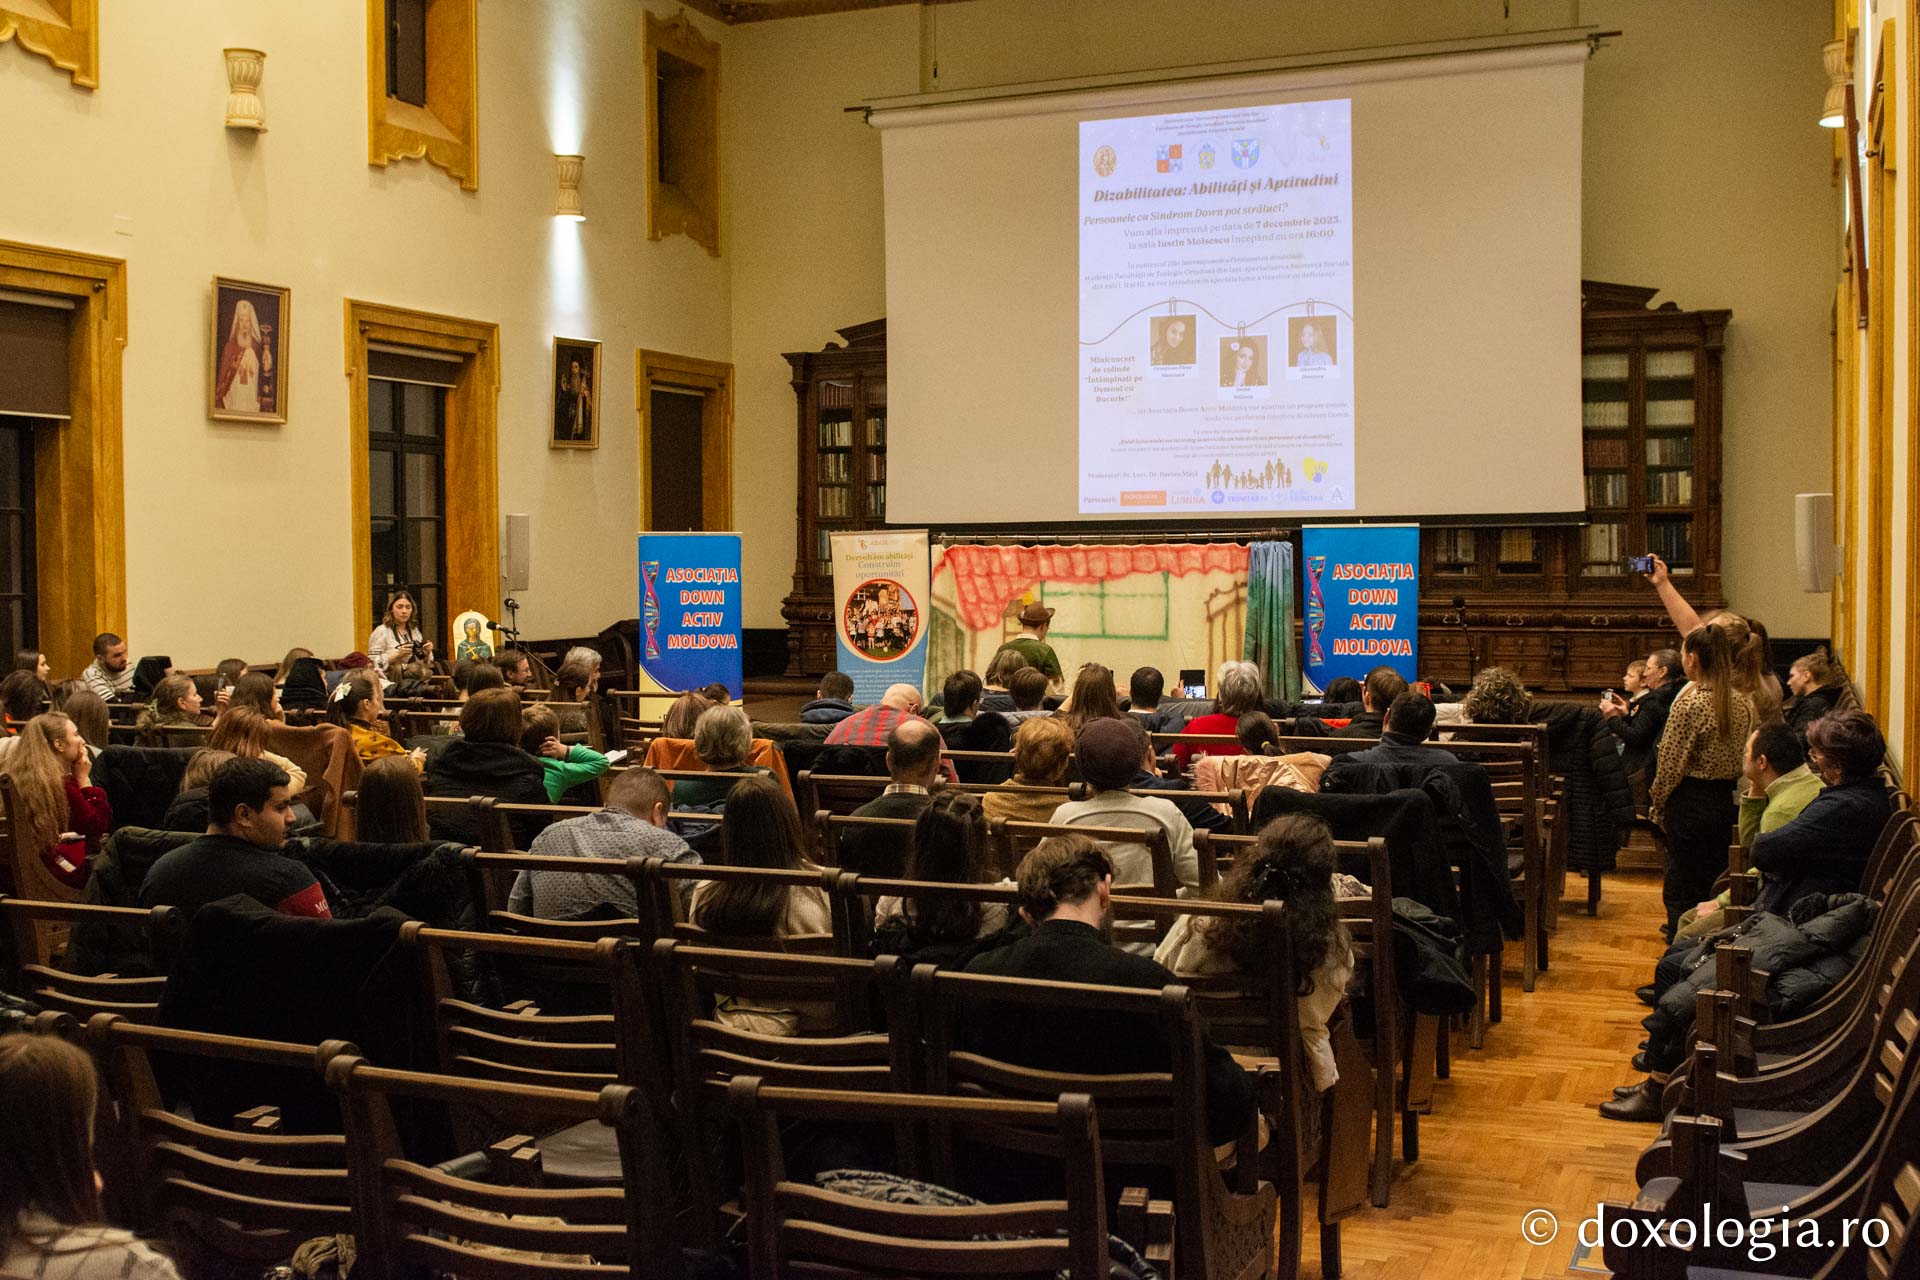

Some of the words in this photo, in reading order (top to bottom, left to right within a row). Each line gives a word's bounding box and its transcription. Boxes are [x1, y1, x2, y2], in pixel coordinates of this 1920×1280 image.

[1094, 185, 1186, 203] Dizabilitatea:
[1190, 178, 1248, 195] Abilități
[1249, 178, 1262, 194] și
[1263, 173, 1339, 192] Aptitudini
[1083, 212, 1135, 225] Persoanele
[1137, 213, 1149, 222] cu
[1149, 209, 1193, 221] Sindrom
[1194, 207, 1223, 218] Down
[1225, 207, 1241, 218] pot
[1242, 201, 1289, 215] străluci?
[1123, 228, 1144, 238] Vom
[1164, 224, 1208, 236] împreună
[1210, 224, 1221, 235] pe
[1222, 221, 1242, 231] data
[1243, 220, 1254, 230] de
[1263, 217, 1312, 229] decembrie
[1157, 239, 1185, 248] Iustin
[1186, 236, 1230, 247] Moisescu
[1090, 355, 1135, 364] Miniconcert
[1103, 365, 1131, 373] colinde
[1134, 375, 1144, 384] pe
[1093, 385, 1123, 393] Domnul
[857, 561, 901, 569] Construim
[1332, 563, 1414, 582] ASOCIAȚIA
[666, 568, 738, 585] ASOCIAȚIA
[680, 590, 724, 605] DOWN
[1348, 588, 1398, 605] DOWN
[682, 612, 723, 627] ACTIV
[1350, 614, 1396, 630] ACTIV
[667, 634, 737, 649] MOLDOVA
[1333, 639, 1412, 656] MOLDOVA
